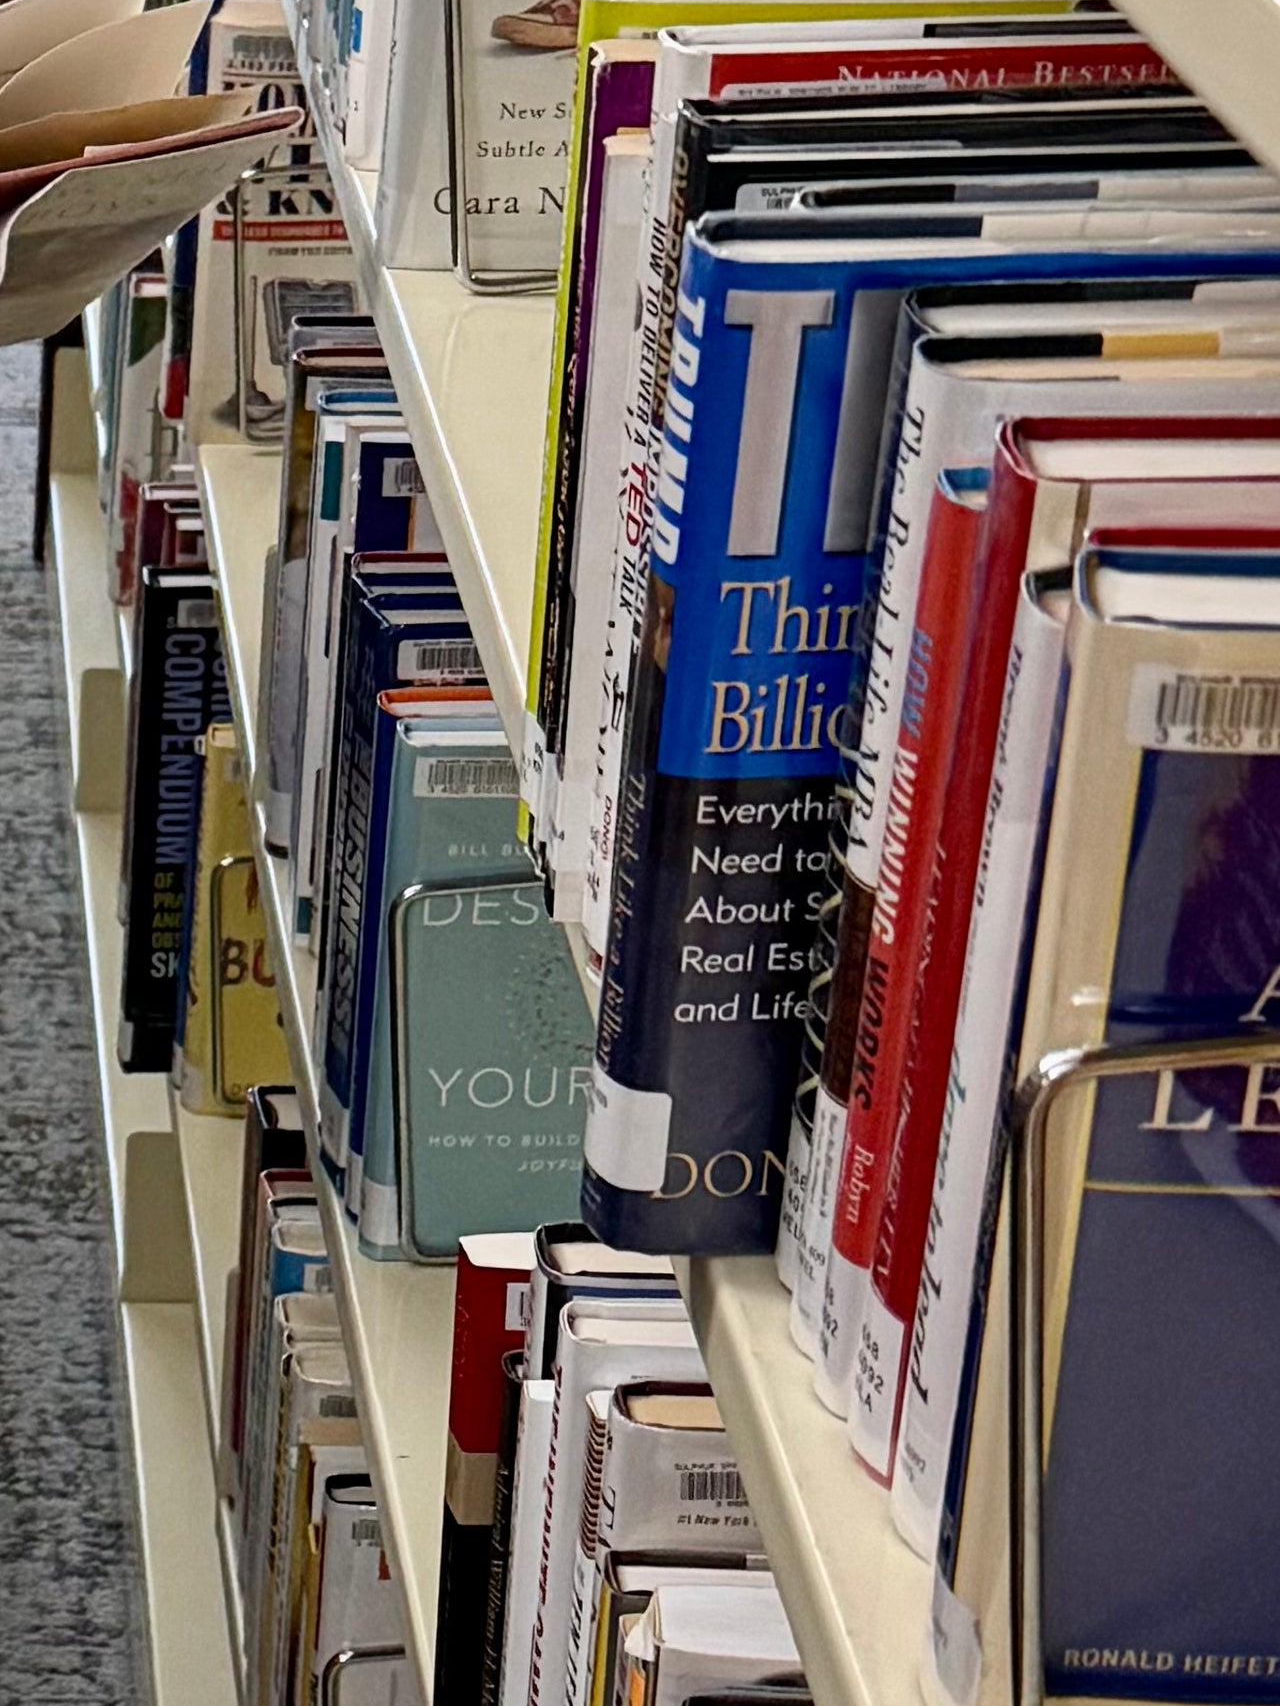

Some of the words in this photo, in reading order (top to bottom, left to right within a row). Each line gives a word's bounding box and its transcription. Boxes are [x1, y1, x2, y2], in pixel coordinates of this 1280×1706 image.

[499, 102, 547, 120] New
[476, 140, 547, 159] Subtle
[649, 217, 667, 277] HOW
[645, 285, 663, 316] TO
[635, 326, 657, 424] DELIVER
[888, 404, 926, 494] The
[625, 461, 647, 547] TED
[618, 555, 638, 614] TALK
[154, 632, 207, 866] COMPENDIUM
[621, 774, 646, 864] Think
[690, 845, 783, 877] Need
[794, 848, 829, 875] to
[871, 745, 919, 944] WINNING
[684, 895, 794, 927] About
[680, 944, 755, 975] Real
[673, 993, 739, 1025] and
[428, 1066, 594, 1109] YOUR
[427, 1135, 477, 1148] HOW
[487, 1135, 512, 1147] TO
[520, 1134, 581, 1147] BUILD
[845, 1144, 874, 1225] Robyn
[1064, 1648, 1173, 1673] RONALD
